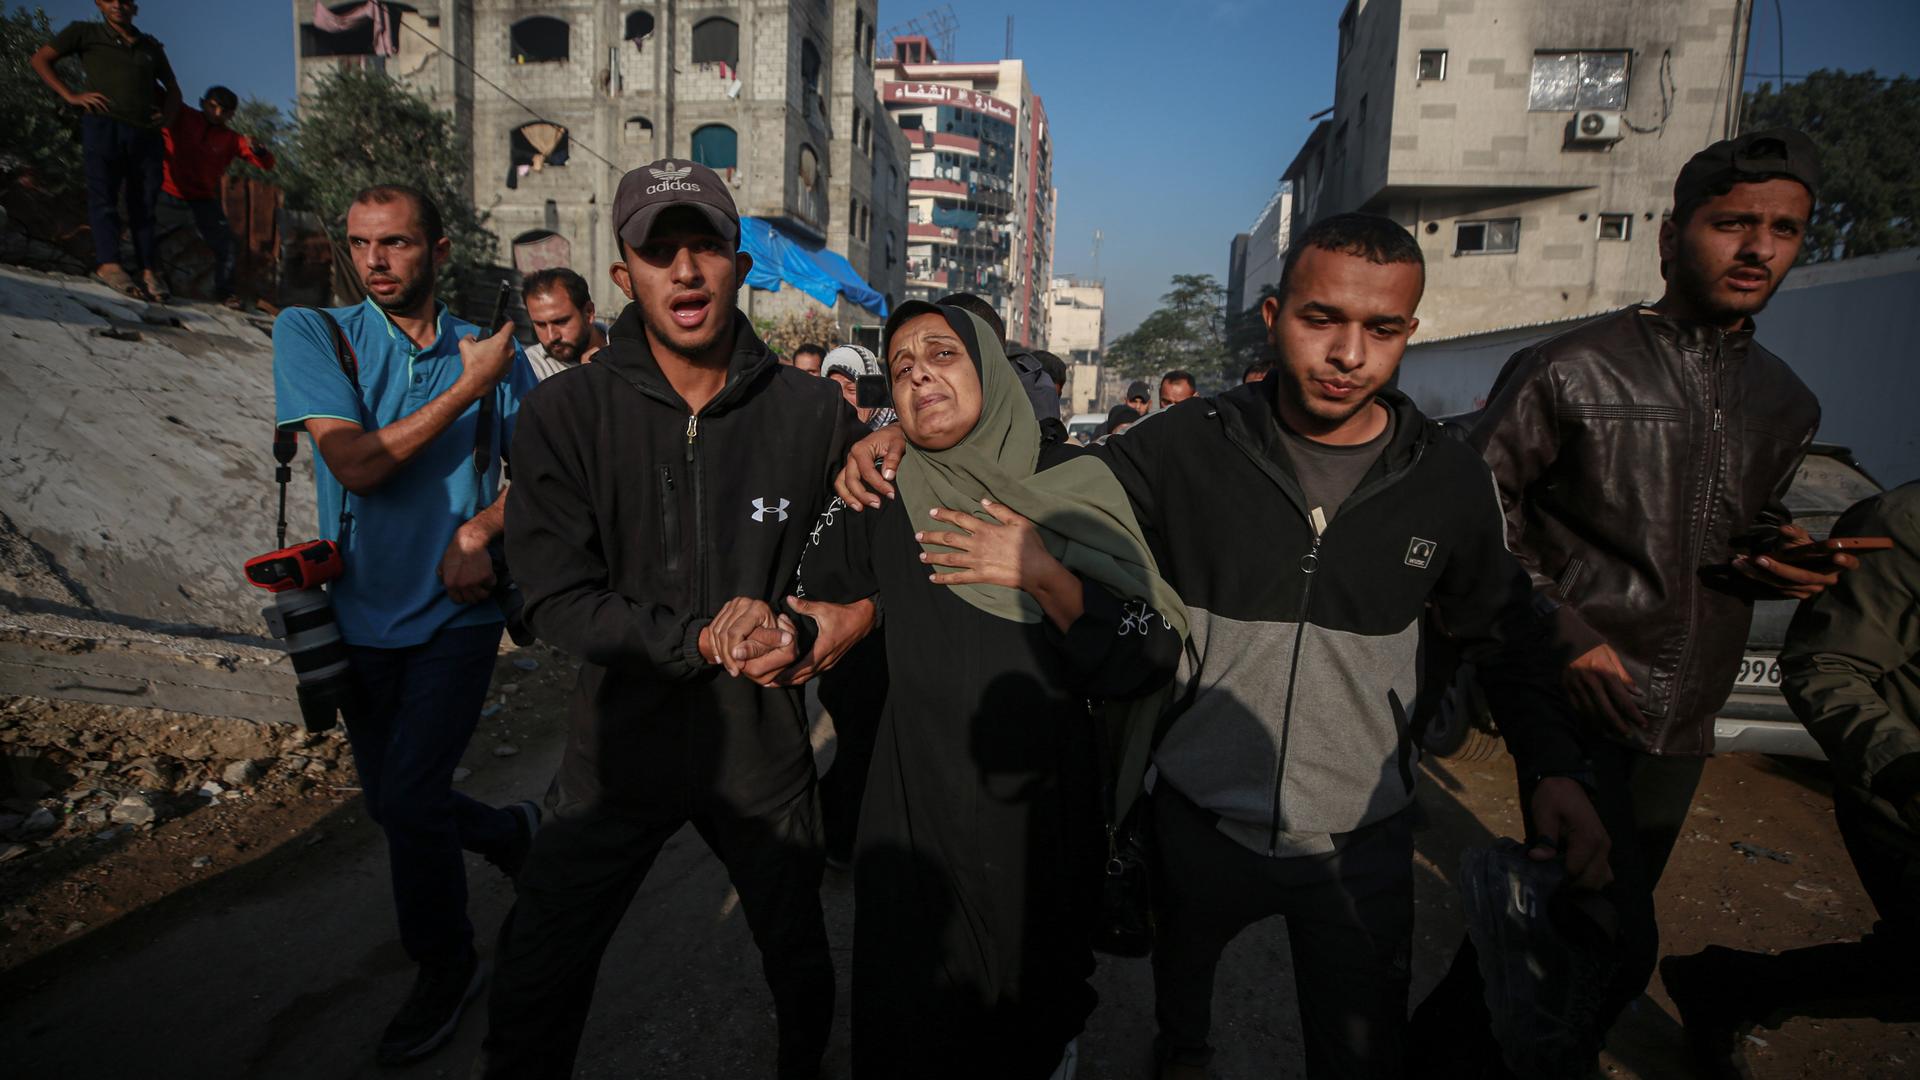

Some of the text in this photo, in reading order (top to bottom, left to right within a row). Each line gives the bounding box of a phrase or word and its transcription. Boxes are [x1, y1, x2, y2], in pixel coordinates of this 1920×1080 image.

[895, 84, 1012, 118] عمارة الشفاء
[646, 180, 701, 195] adidas
